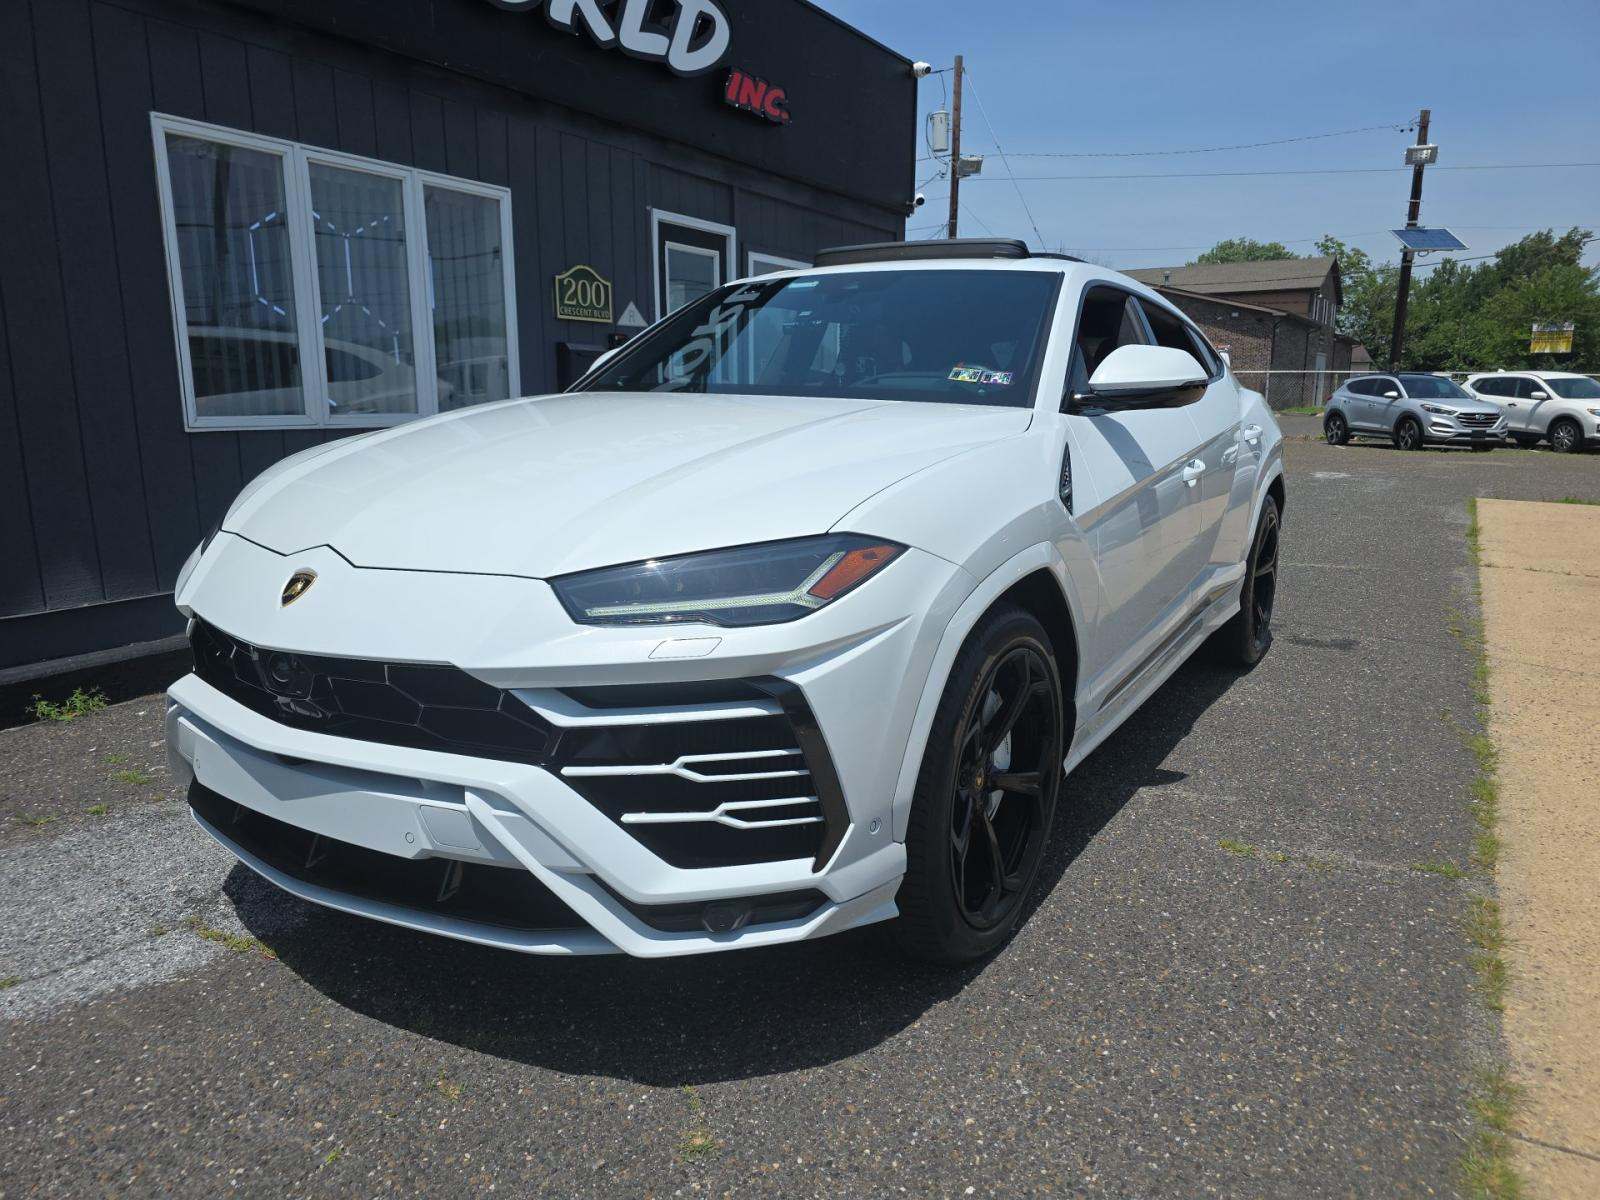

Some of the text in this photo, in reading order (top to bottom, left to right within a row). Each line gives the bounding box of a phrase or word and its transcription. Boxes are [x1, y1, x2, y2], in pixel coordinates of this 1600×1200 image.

[727, 72, 790, 120] INC.
[563, 278, 605, 308] 200
[560, 306, 610, 319] CRESCENT BLVD
